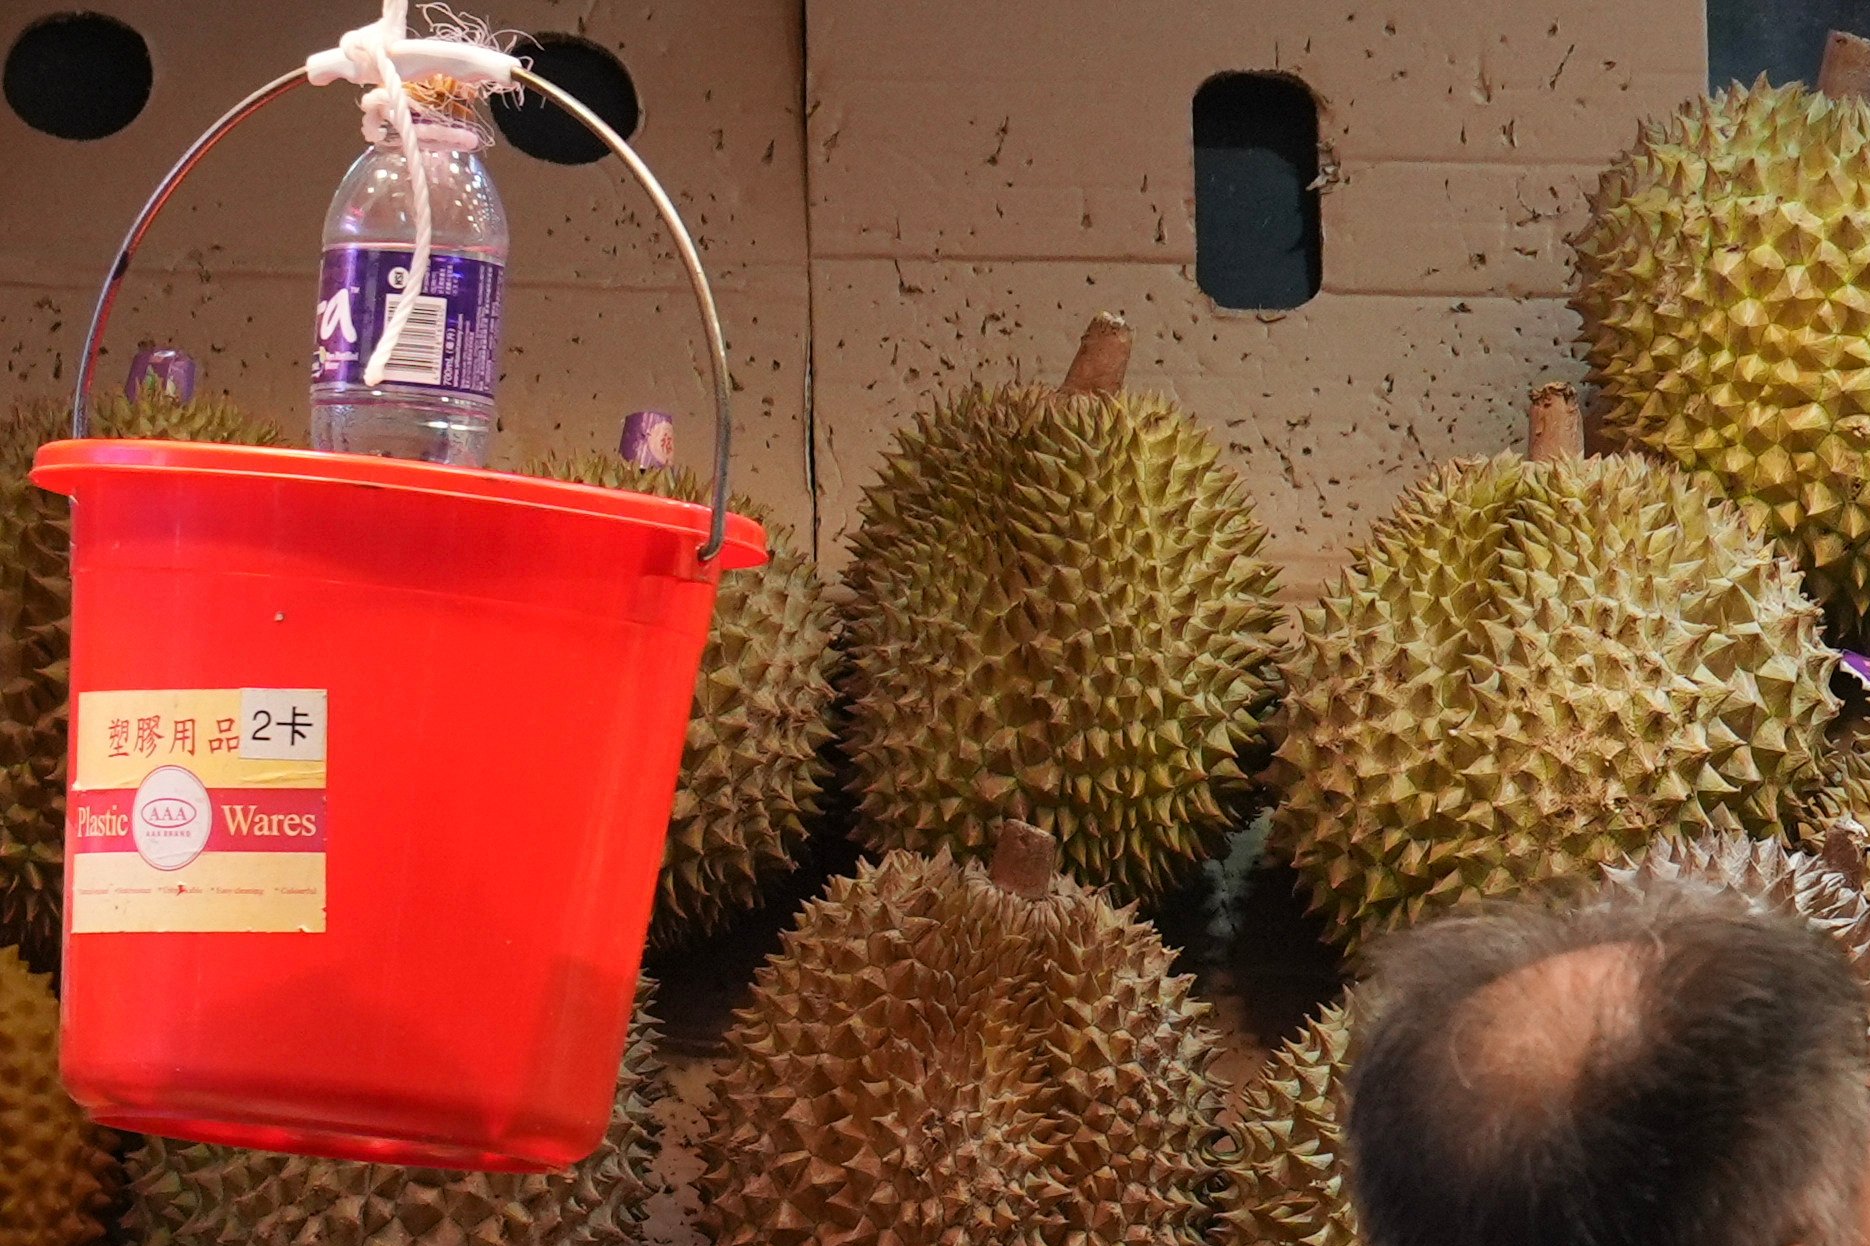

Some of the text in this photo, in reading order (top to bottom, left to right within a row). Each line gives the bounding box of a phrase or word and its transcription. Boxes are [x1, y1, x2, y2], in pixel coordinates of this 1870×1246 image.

[108, 714, 240, 758] 塑膠用品
[252, 706, 313, 746] 2卡
[77, 804, 317, 838] Plastic Wares
[149, 807, 187, 821] AAA
